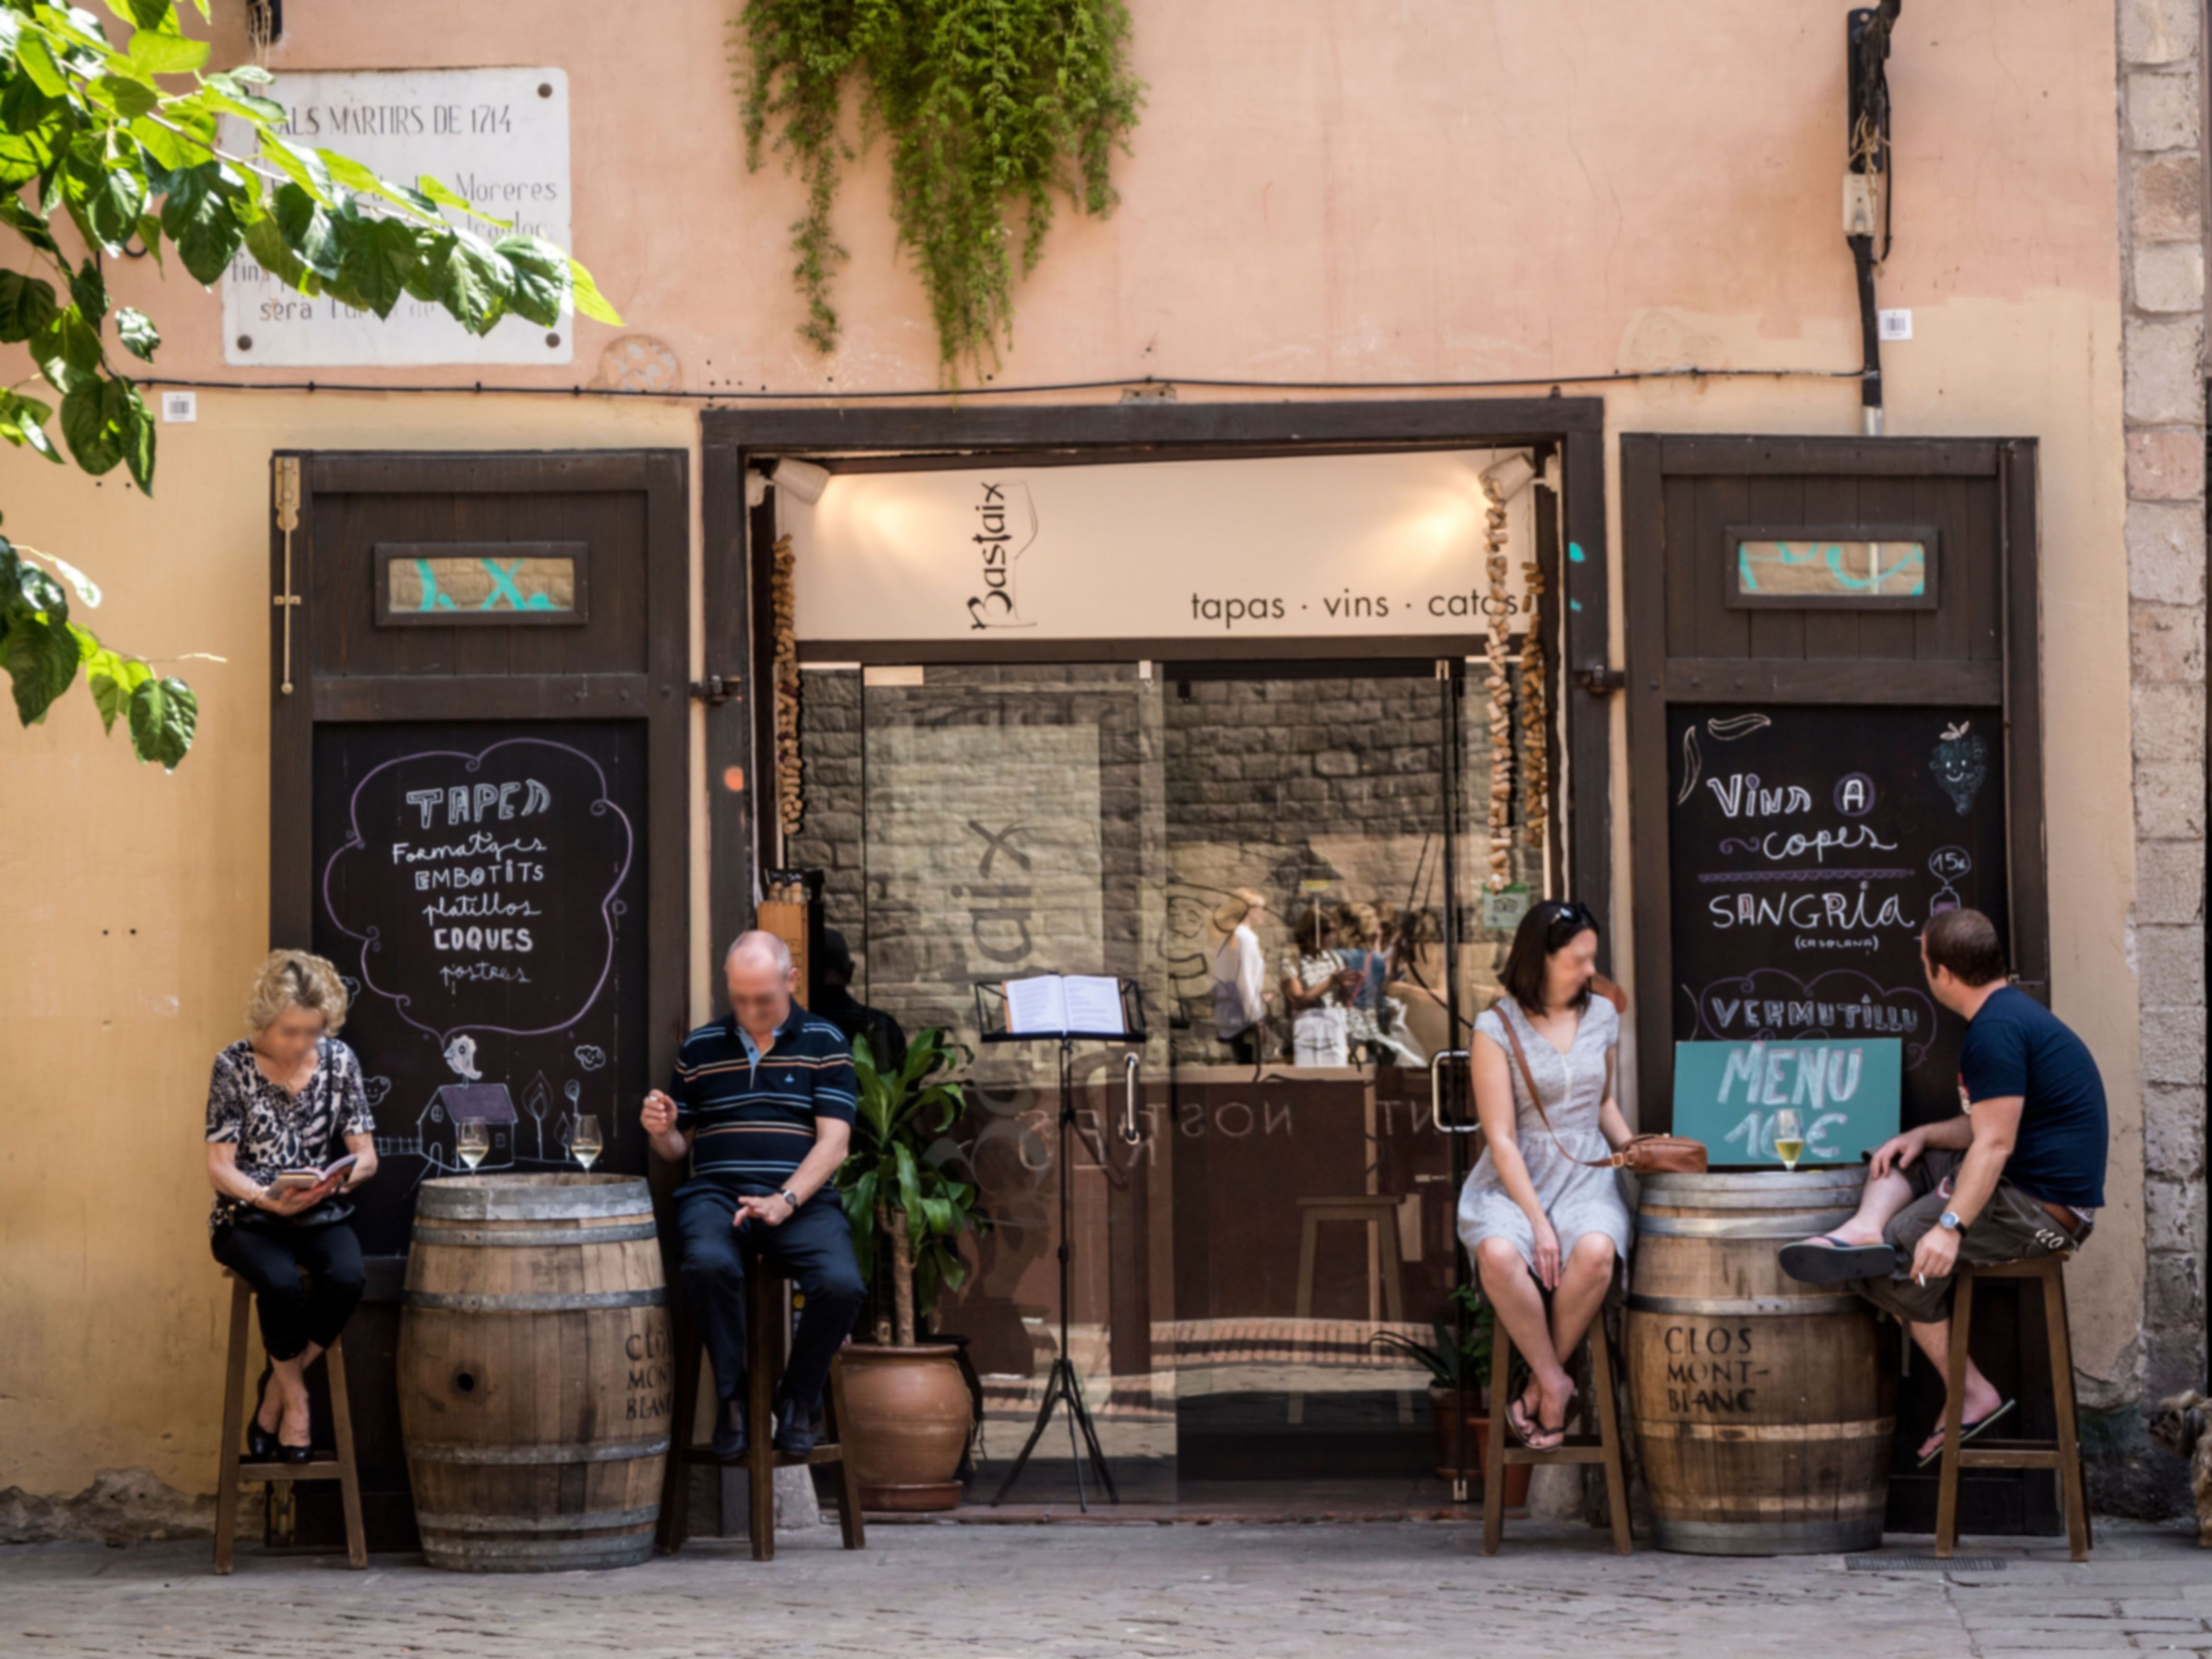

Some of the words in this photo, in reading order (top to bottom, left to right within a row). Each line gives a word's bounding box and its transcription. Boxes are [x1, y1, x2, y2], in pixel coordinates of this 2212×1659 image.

[433, 105, 462, 135] DE
[471, 104, 511, 134] 1714
[456, 173, 557, 202] Moreres
[966, 481, 1013, 630] Bastaix
[1191, 593, 1285, 629] tapas
[1323, 588, 1389, 617] vins
[1842, 779, 1865, 811] A
[1763, 824, 1898, 863] copes
[421, 891, 542, 927] platillos
[433, 926, 533, 952] COQUES
[439, 961, 532, 987] postres
[1717, 1041, 1863, 1109] MENU
[1664, 1326, 1753, 1355] CLOS
[1666, 1360, 1770, 1384] MONT-
[1668, 1388, 1757, 1413] BLANC
